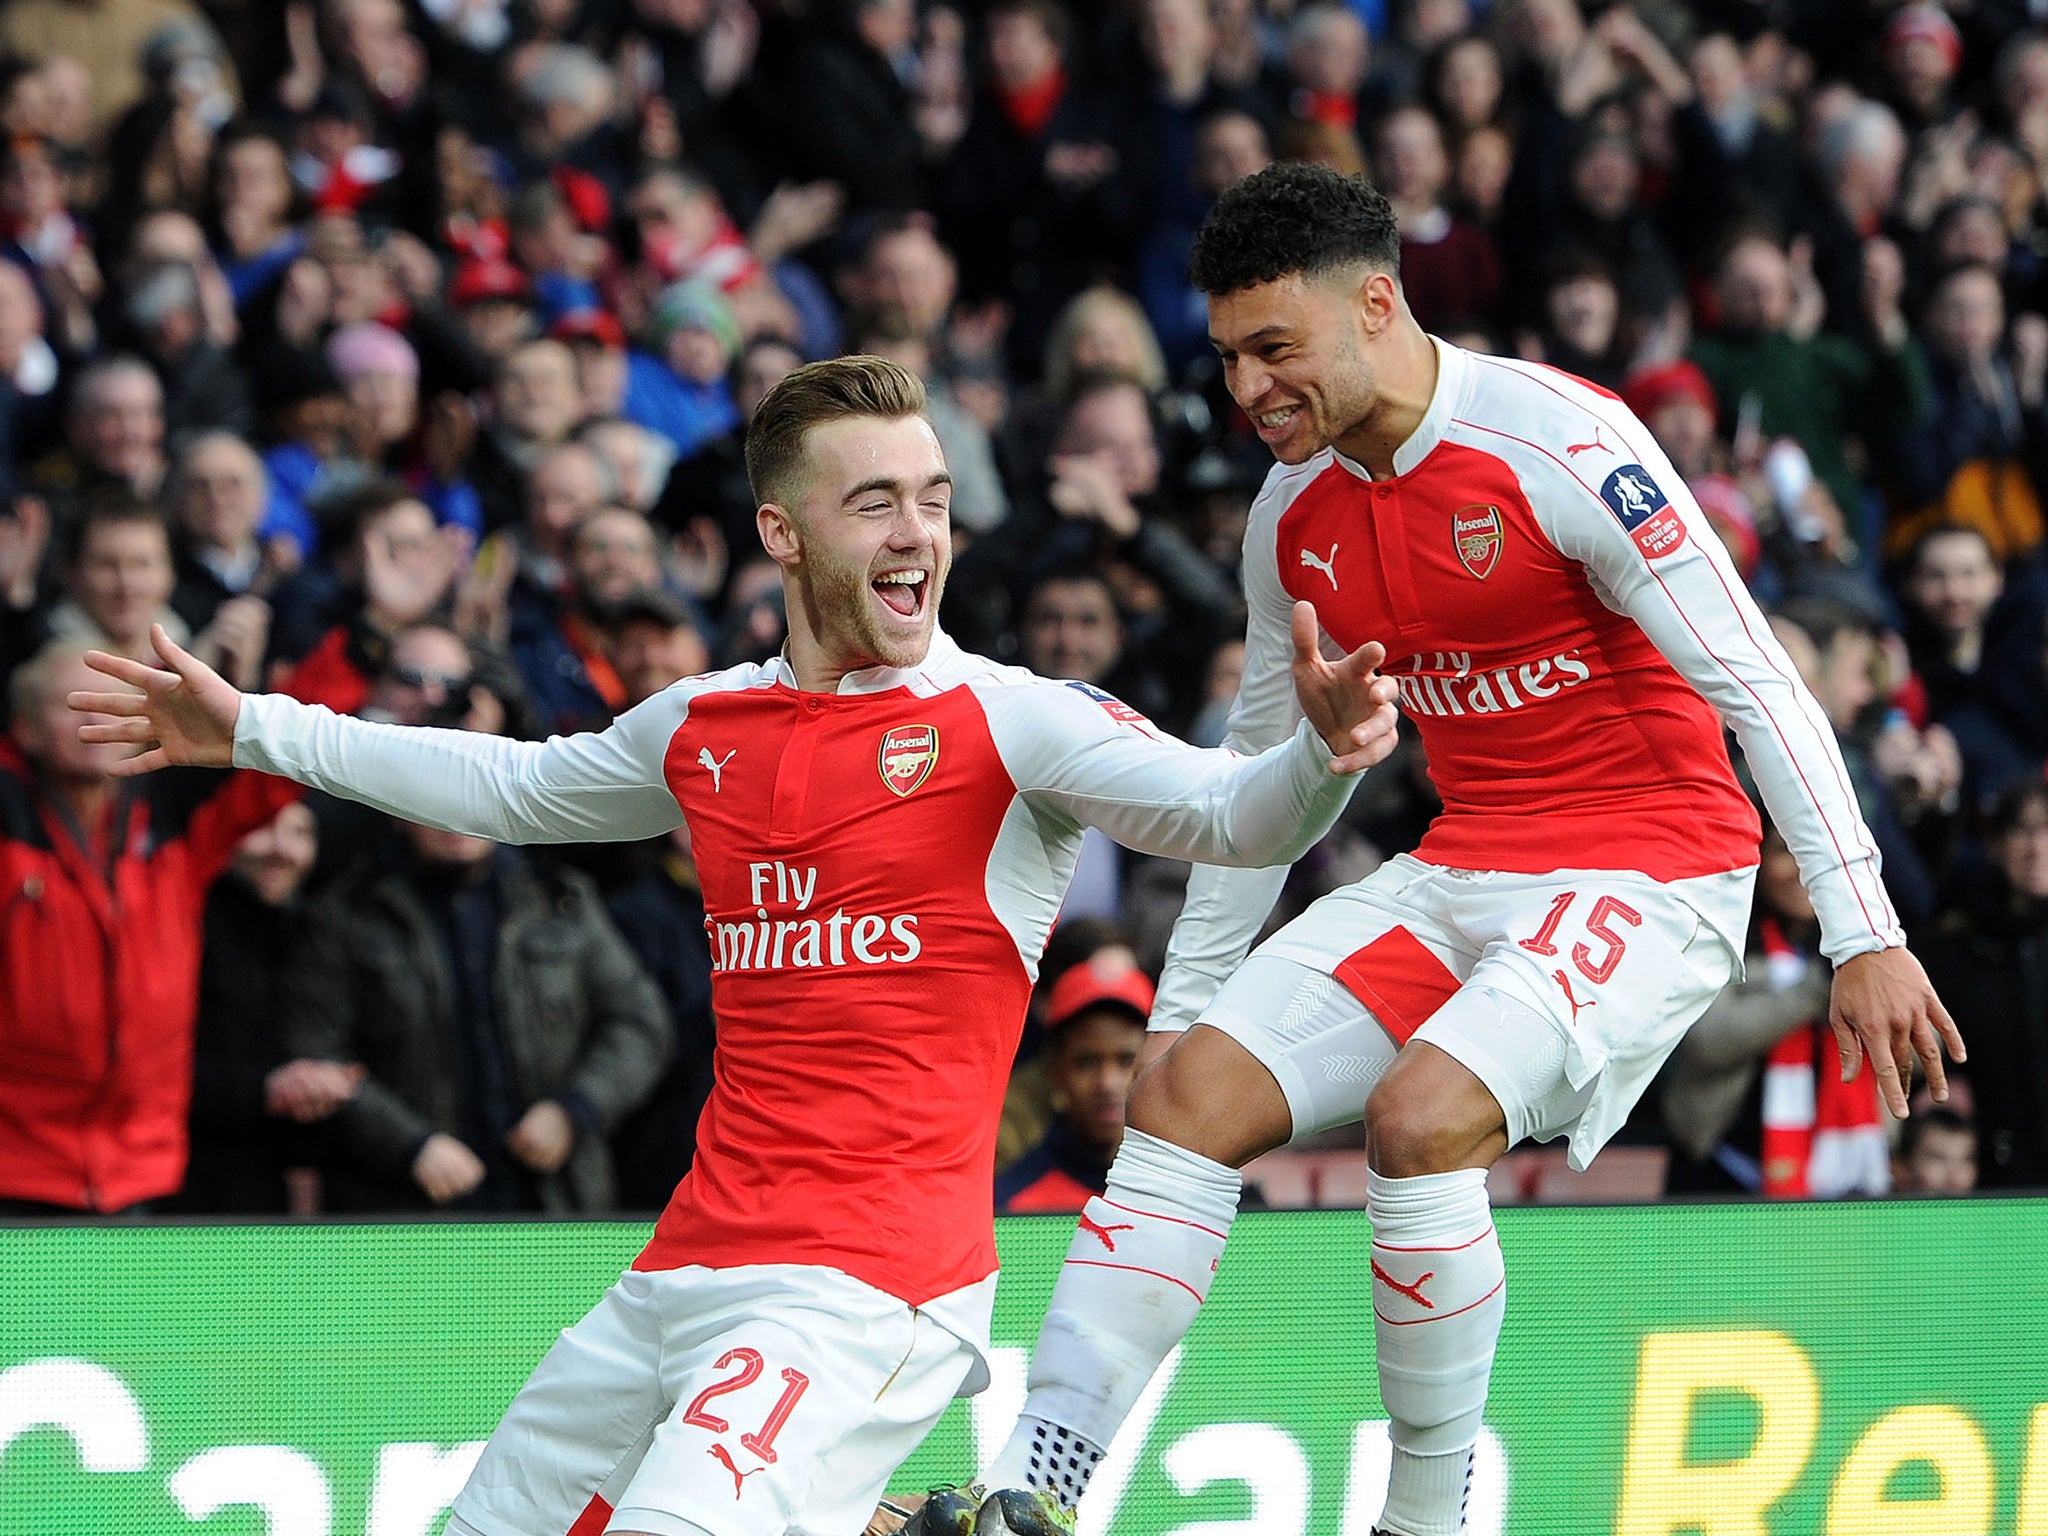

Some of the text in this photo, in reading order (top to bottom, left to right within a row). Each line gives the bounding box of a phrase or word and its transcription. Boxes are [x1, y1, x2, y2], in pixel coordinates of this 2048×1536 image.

[1456, 514, 1494, 532] Arsenal
[1640, 518, 1679, 548] Emirates
[1393, 649, 1590, 716] mirates
[886, 734, 930, 750] Arsenal
[750, 861, 817, 910] Fly
[1518, 891, 1642, 985] 15
[682, 1347, 810, 1464] 21
